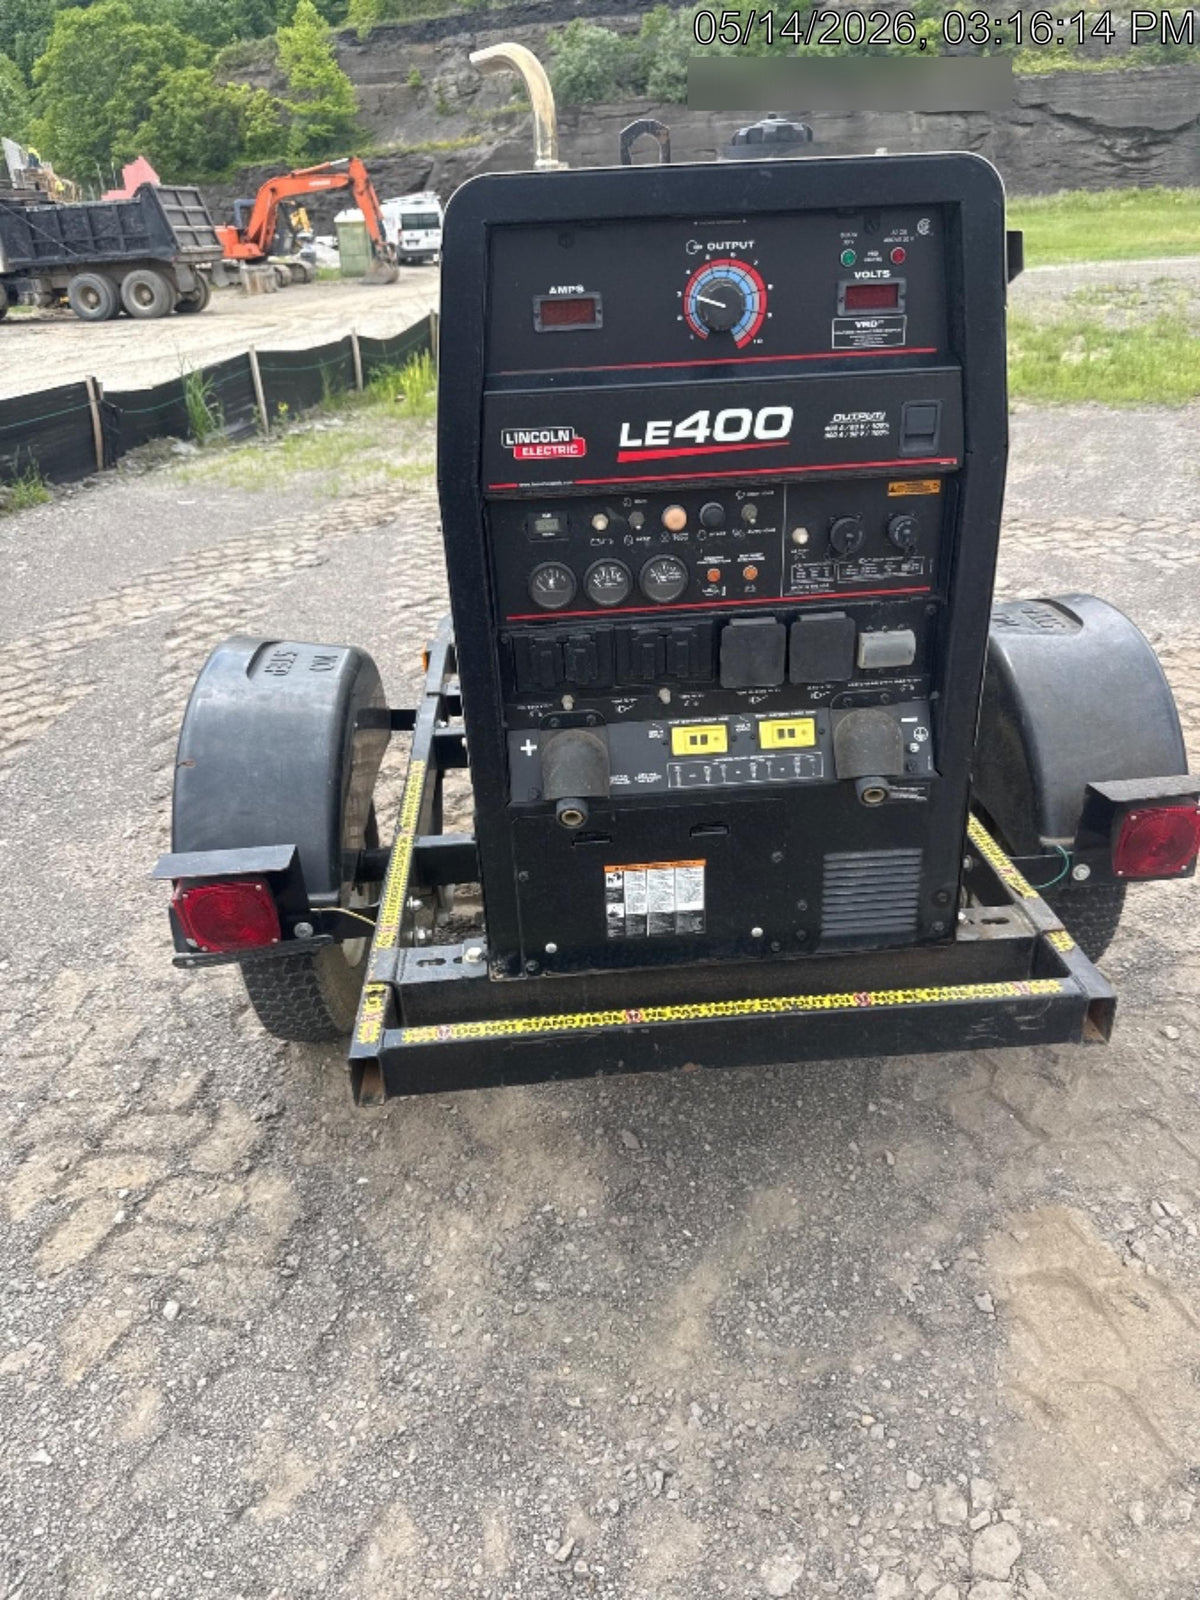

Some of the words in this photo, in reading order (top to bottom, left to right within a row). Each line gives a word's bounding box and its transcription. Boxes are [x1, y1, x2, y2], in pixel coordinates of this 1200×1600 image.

[706, 240, 755, 251] OUTPUT
[853, 269, 892, 279] VOLTS
[548, 284, 586, 294] AMPS
[618, 405, 795, 448] LE400
[505, 429, 571, 445] LINCOLN
[521, 443, 579, 456] ELECTRIC
[456, 1025, 481, 1036] DO
[484, 1023, 517, 1033] NOT
[522, 1017, 576, 1028] STAND
